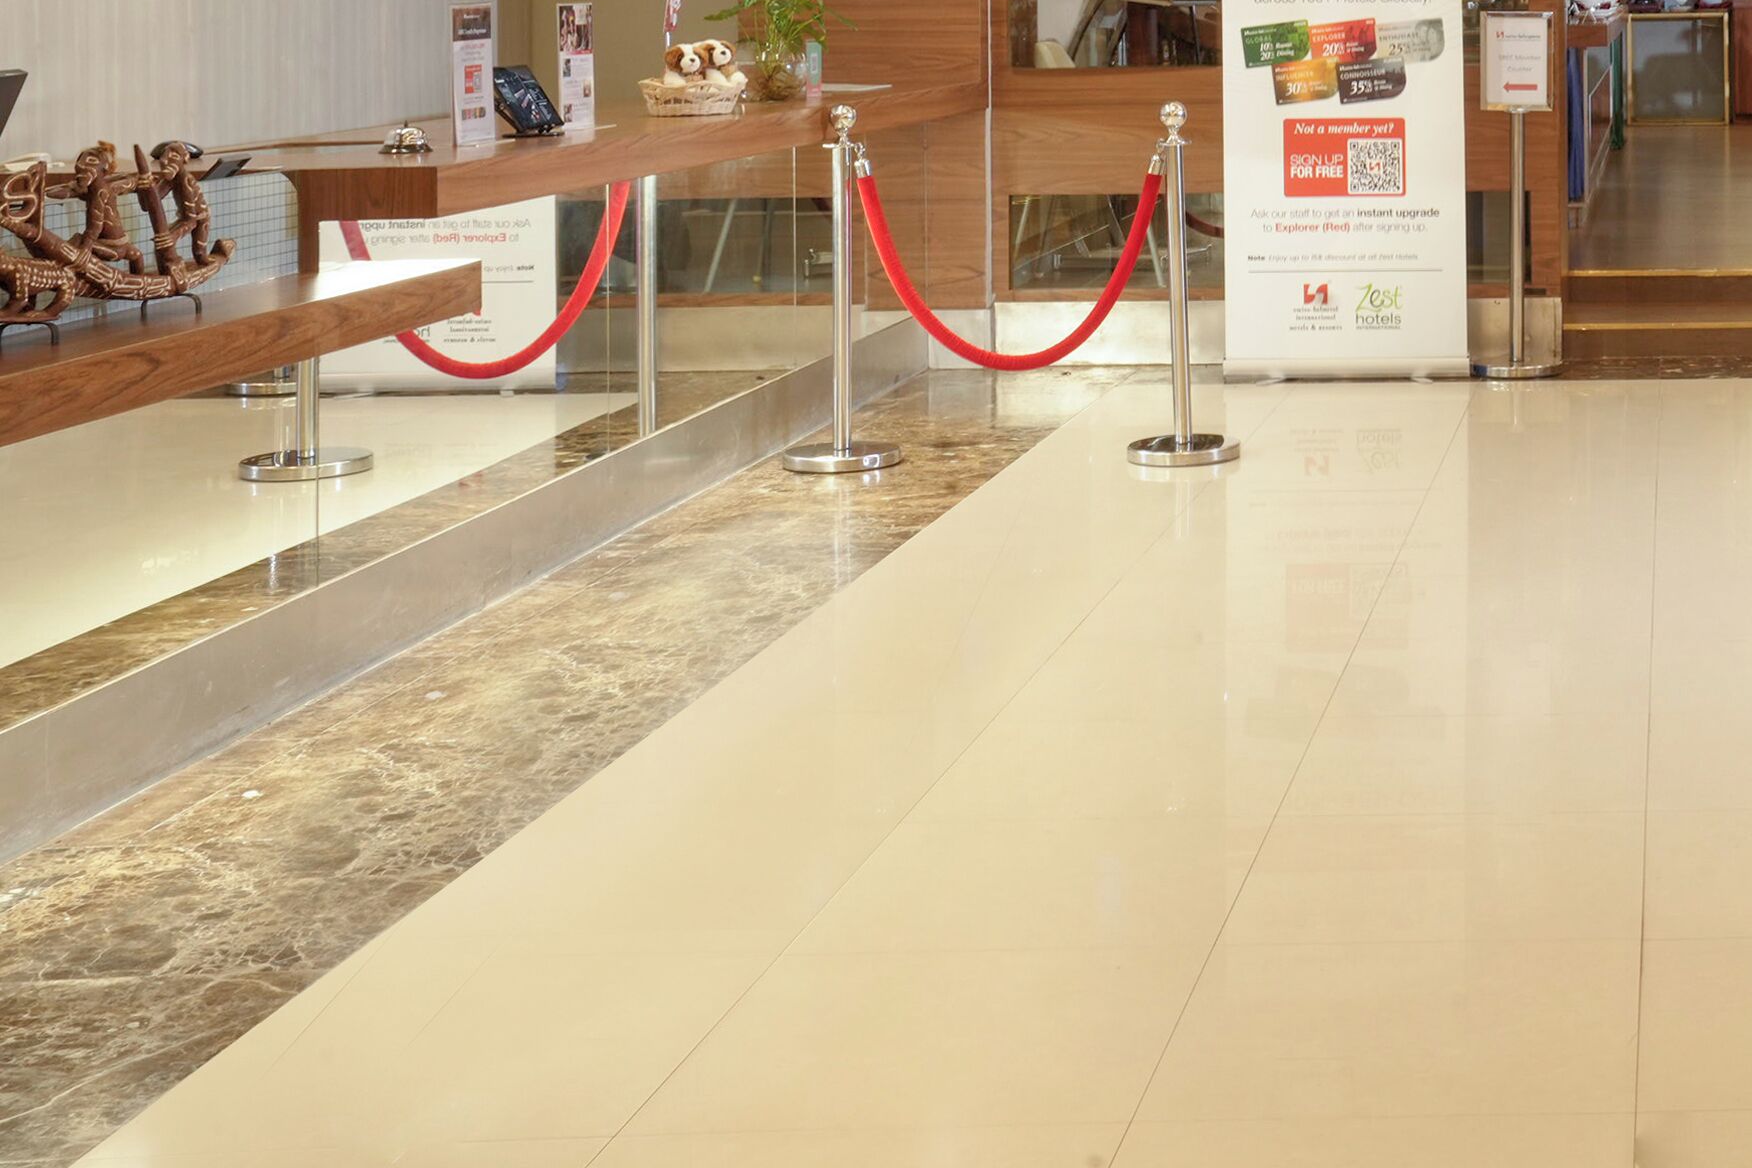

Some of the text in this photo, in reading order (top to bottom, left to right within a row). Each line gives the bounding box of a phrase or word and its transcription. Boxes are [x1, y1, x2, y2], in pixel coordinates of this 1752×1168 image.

[1294, 122, 1395, 137] Not a member yet?
[1290, 154, 1344, 165] SIGN UP
[1290, 166, 1344, 178] FOR FREE
[1251, 209, 1270, 218] Ask
[1289, 208, 1310, 218] staff
[1312, 209, 1322, 218] to
[1325, 209, 1340, 220] get
[1342, 210, 1355, 218] an
[1357, 208, 1393, 218] instant
[1395, 208, 1440, 220] upgrade
[1262, 224, 1272, 233] to
[1275, 223, 1319, 234] Explorer
[1322, 222, 1350, 234] (Red)
[1352, 222, 1373, 232] after
[1376, 223, 1410, 234] signing
[1355, 283, 1404, 313] Zest
[1355, 312, 1402, 325] hotels
